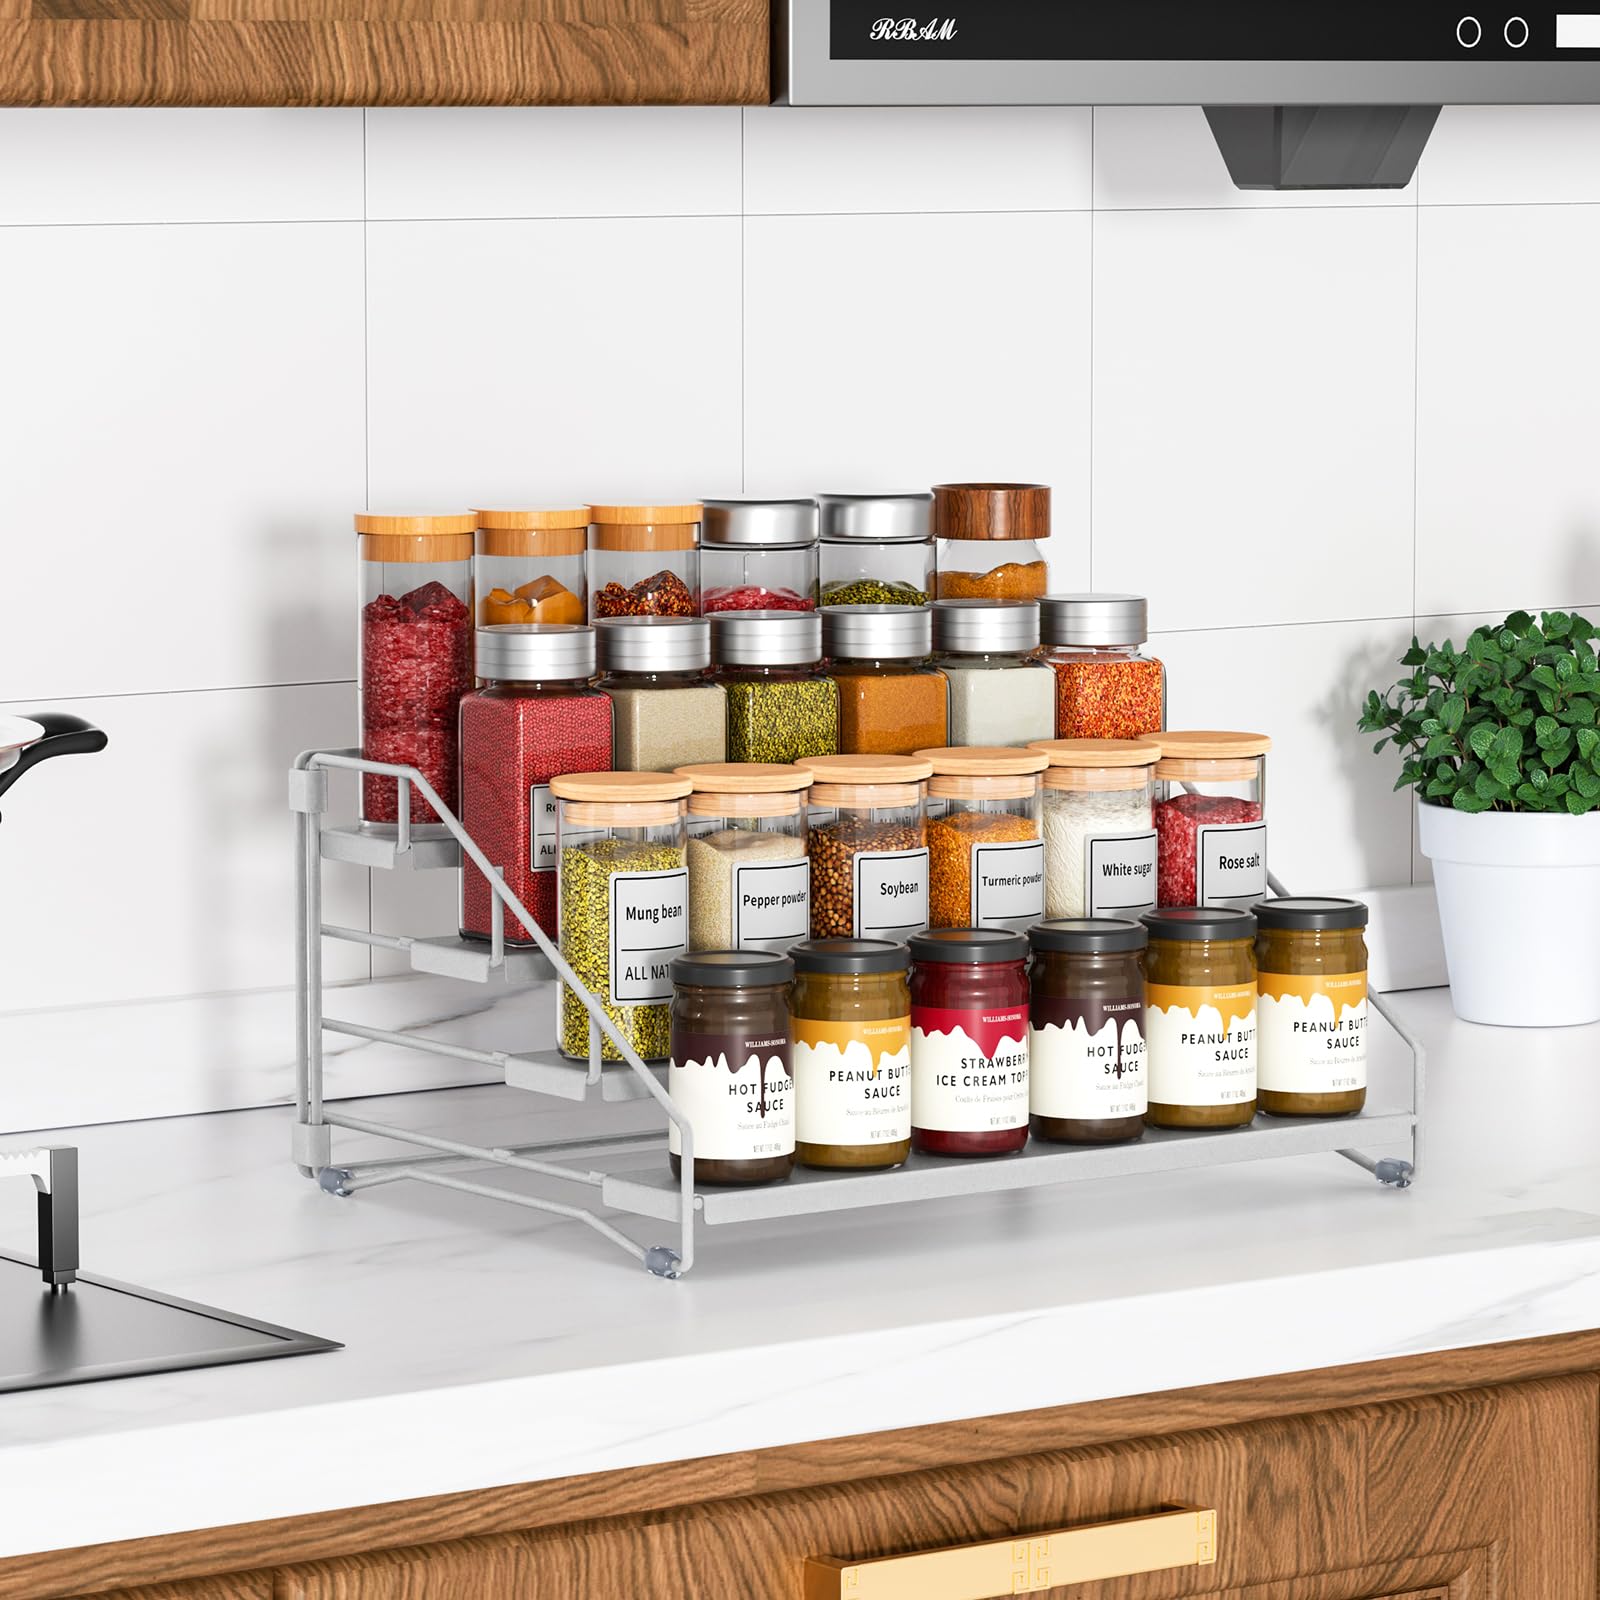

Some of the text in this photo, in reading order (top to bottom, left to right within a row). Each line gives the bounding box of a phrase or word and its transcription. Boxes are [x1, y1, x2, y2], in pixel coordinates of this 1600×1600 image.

[1219, 852, 1260, 870] Rose salt
[1102, 862, 1153, 878] White sugar
[982, 871, 1042, 887] Turmeric powder
[880, 881, 918, 898] Soybean
[743, 890, 807, 909] Pepper powder
[626, 903, 682, 924] Mung bean
[625, 965, 648, 981] ALL
[1293, 1021, 1343, 1033] PEANUT
[1181, 1033, 1232, 1045] PEANUT
[1326, 1036, 1360, 1049] SAUCE
[1087, 1046, 1114, 1057] HOT
[1215, 1048, 1248, 1061] SAUCE
[1104, 1061, 1139, 1074] SAUCE
[829, 1069, 882, 1081] PEANUT
[936, 1075, 957, 1087] ICE
[963, 1074, 1006, 1086] CREAM
[729, 1084, 757, 1095] HOT
[864, 1085, 901, 1099] SAUCE
[747, 1099, 784, 1113] SAUCE
